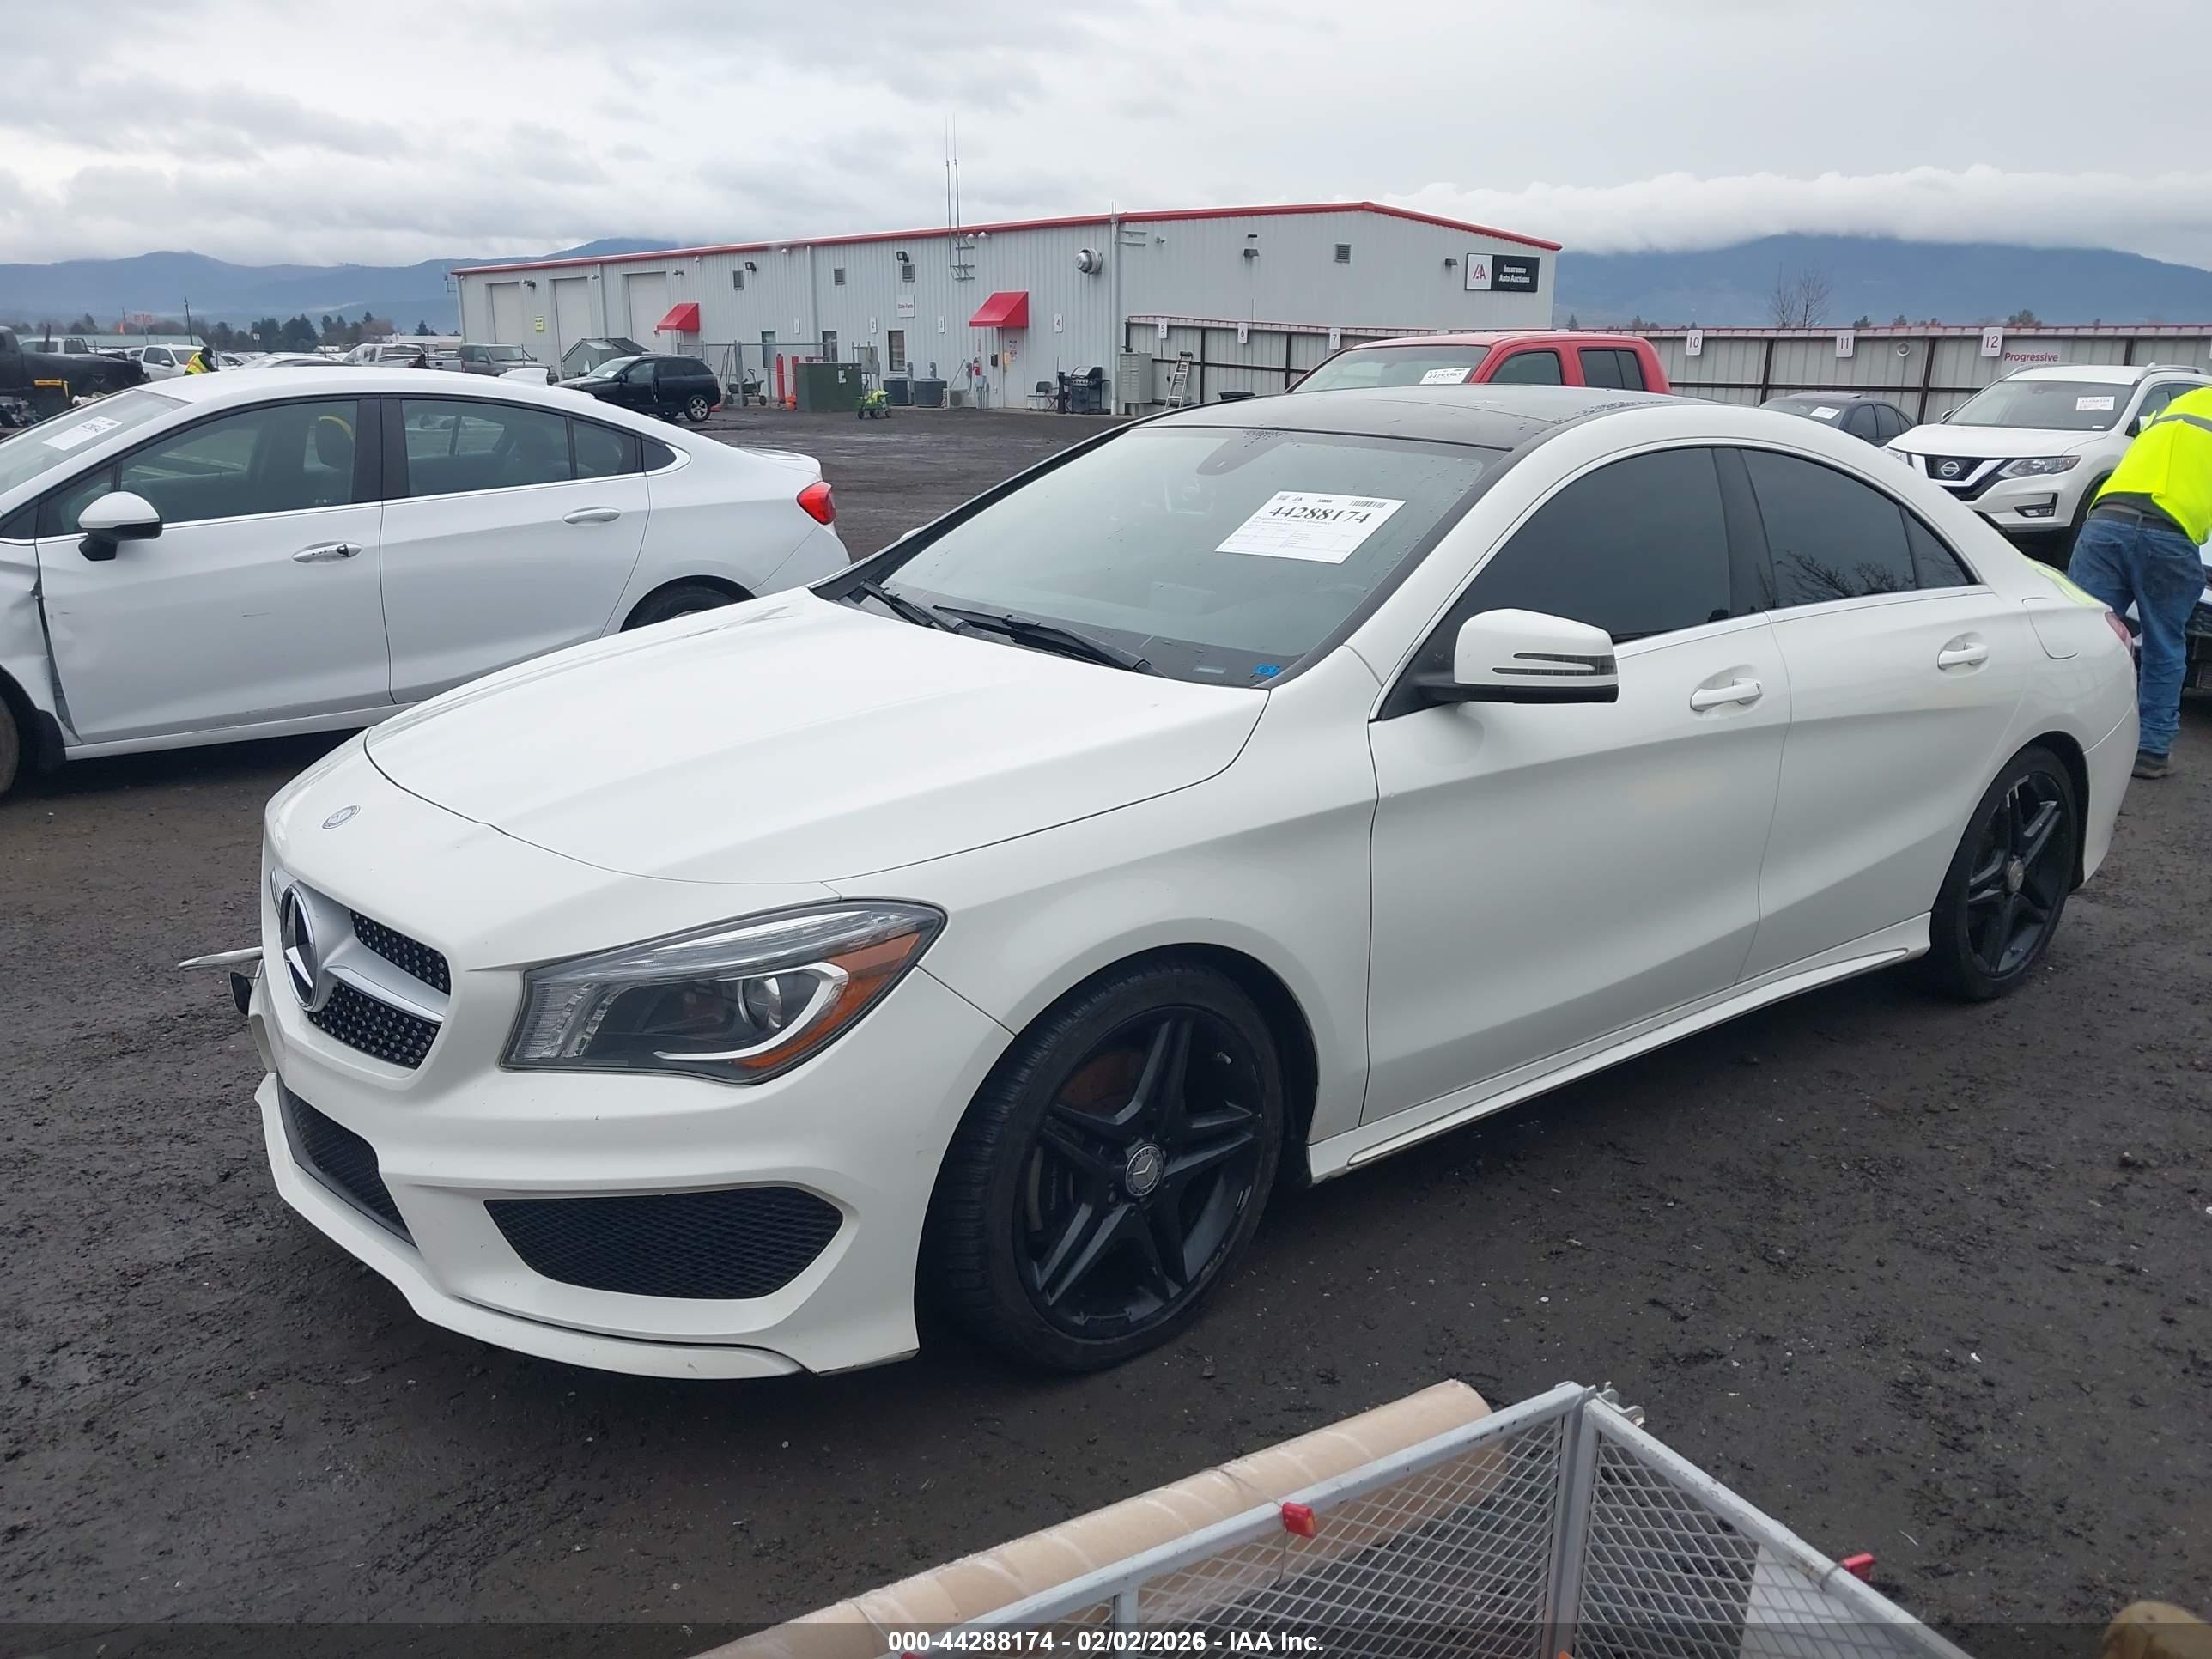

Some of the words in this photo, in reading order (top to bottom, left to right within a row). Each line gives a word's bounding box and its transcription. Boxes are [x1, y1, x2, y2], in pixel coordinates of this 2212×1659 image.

[1498, 274, 1510, 283] Auto
[1510, 275, 1530, 283] Auctions
[1332, 333, 1338, 343] 7
[1688, 337, 1700, 349] 10
[1839, 337, 1850, 350] 11
[1985, 335, 1999, 349] 12
[2004, 352, 2059, 363] Progressive
[1268, 506, 1372, 524] 44288174
